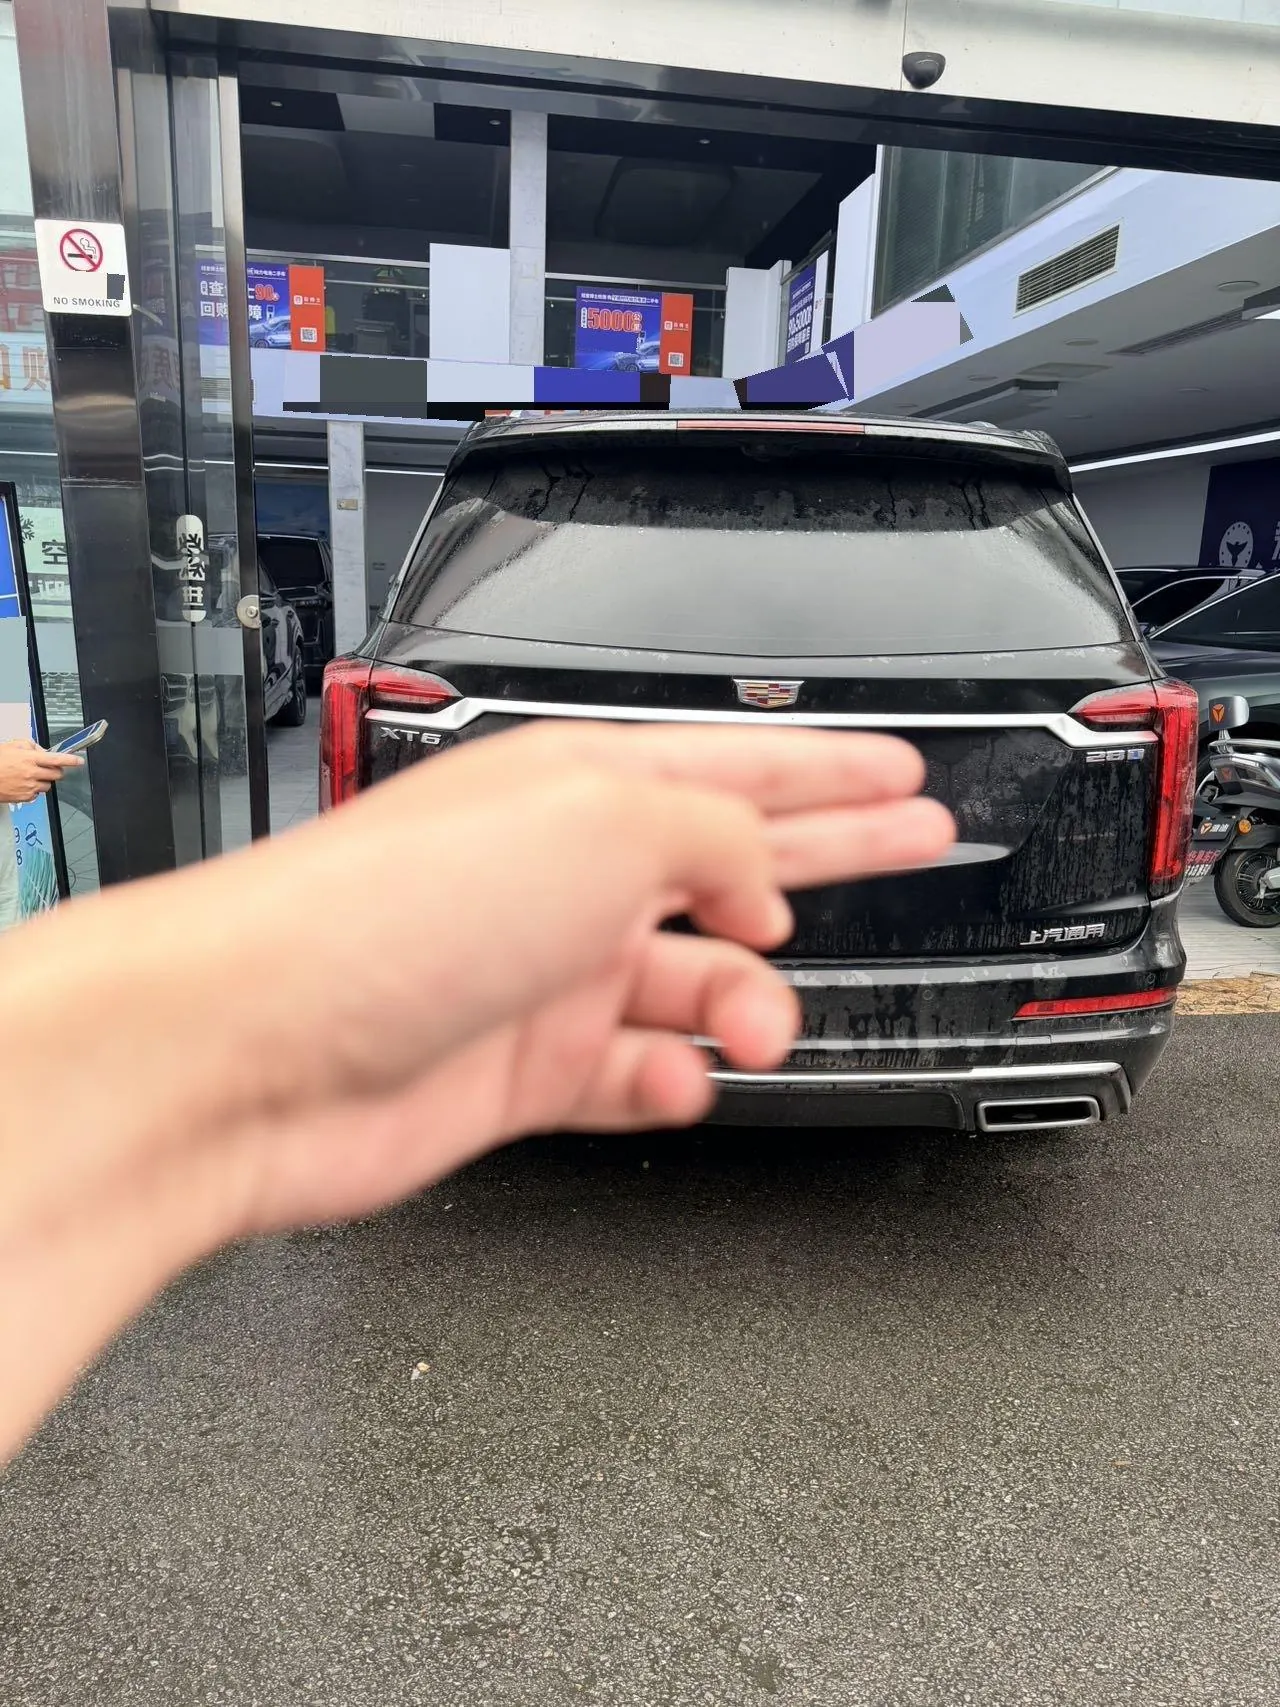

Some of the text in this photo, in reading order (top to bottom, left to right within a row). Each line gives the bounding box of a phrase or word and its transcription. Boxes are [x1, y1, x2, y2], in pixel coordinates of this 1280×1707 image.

[53, 297, 120, 308] NO SMOKING
[380, 726, 442, 745] XT6
[1019, 923, 1106, 946] 上汽通用
